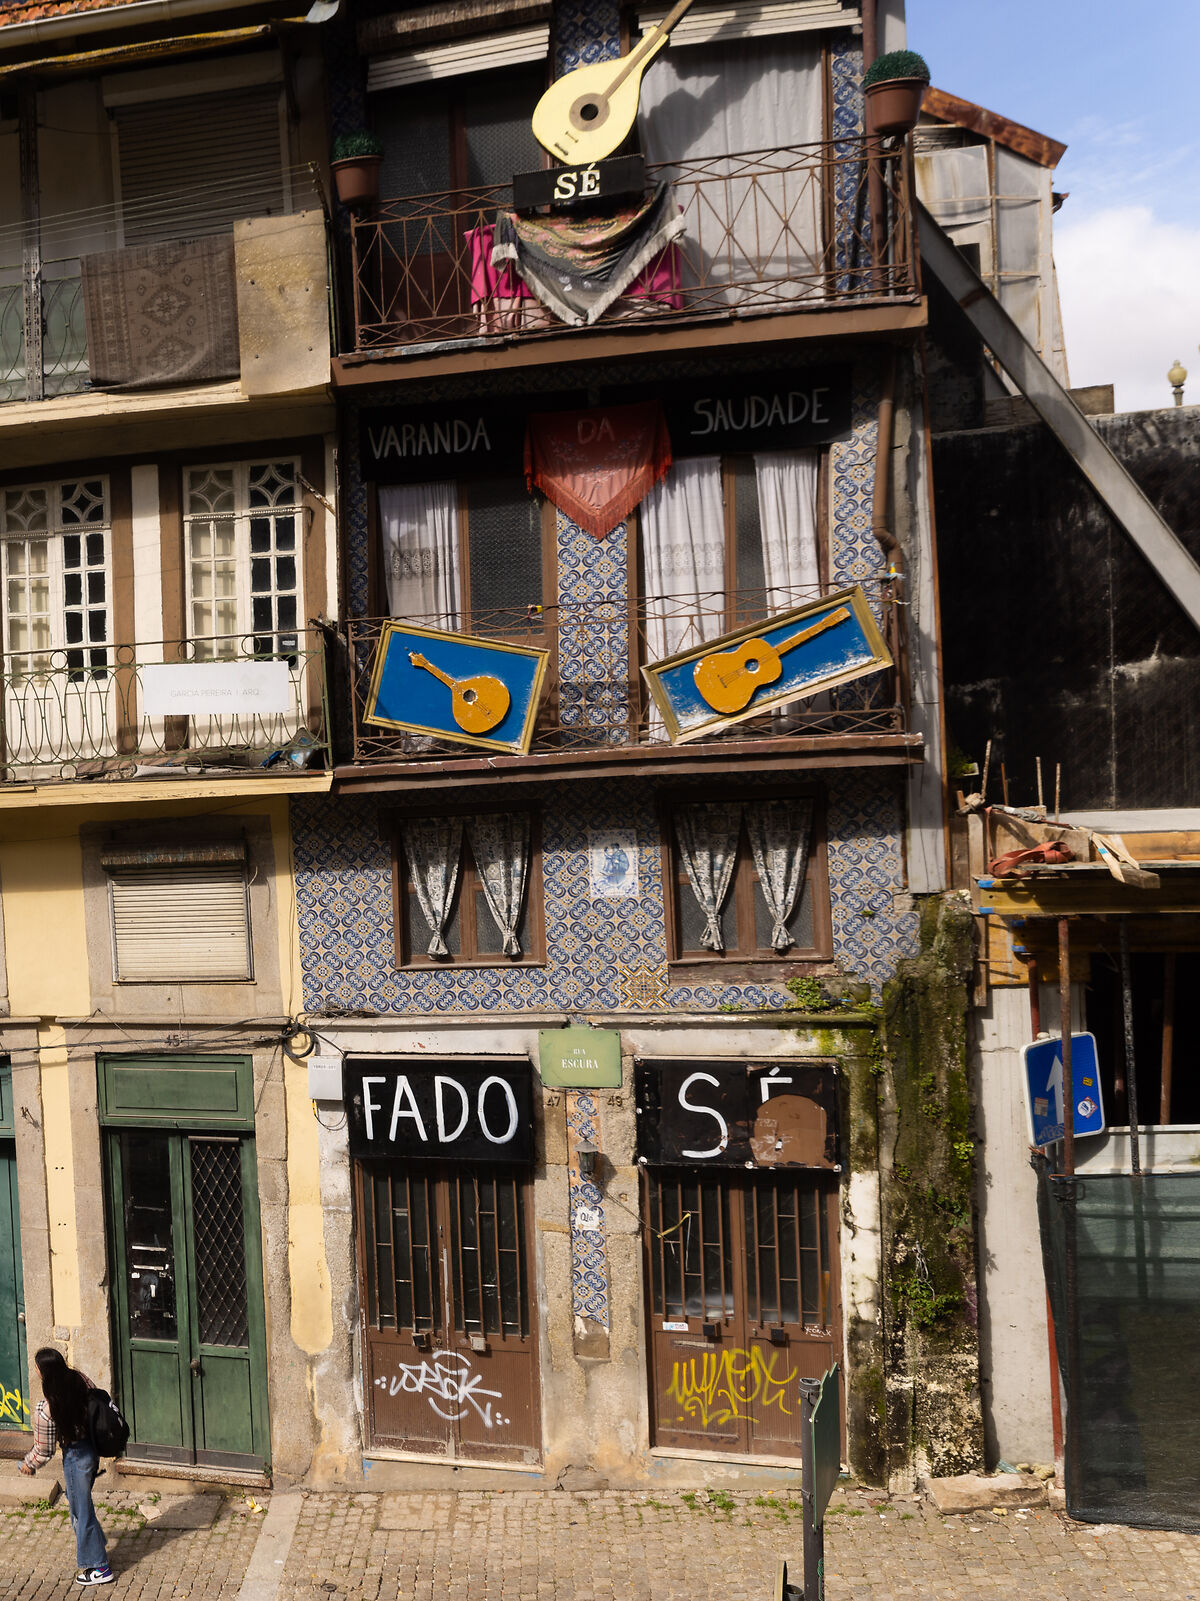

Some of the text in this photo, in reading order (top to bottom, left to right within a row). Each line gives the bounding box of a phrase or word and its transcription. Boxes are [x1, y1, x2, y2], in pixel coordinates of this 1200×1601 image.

[554, 162, 601, 199] SÉ
[368, 388, 831, 460] VARANDA DA SAUDADE
[573, 1048, 586, 1056] RUA
[561, 1059, 599, 1069] ESCURA
[546, 1096, 561, 1107] 47
[607, 1095, 623, 1108] 49
[361, 1075, 519, 1143] FADO
